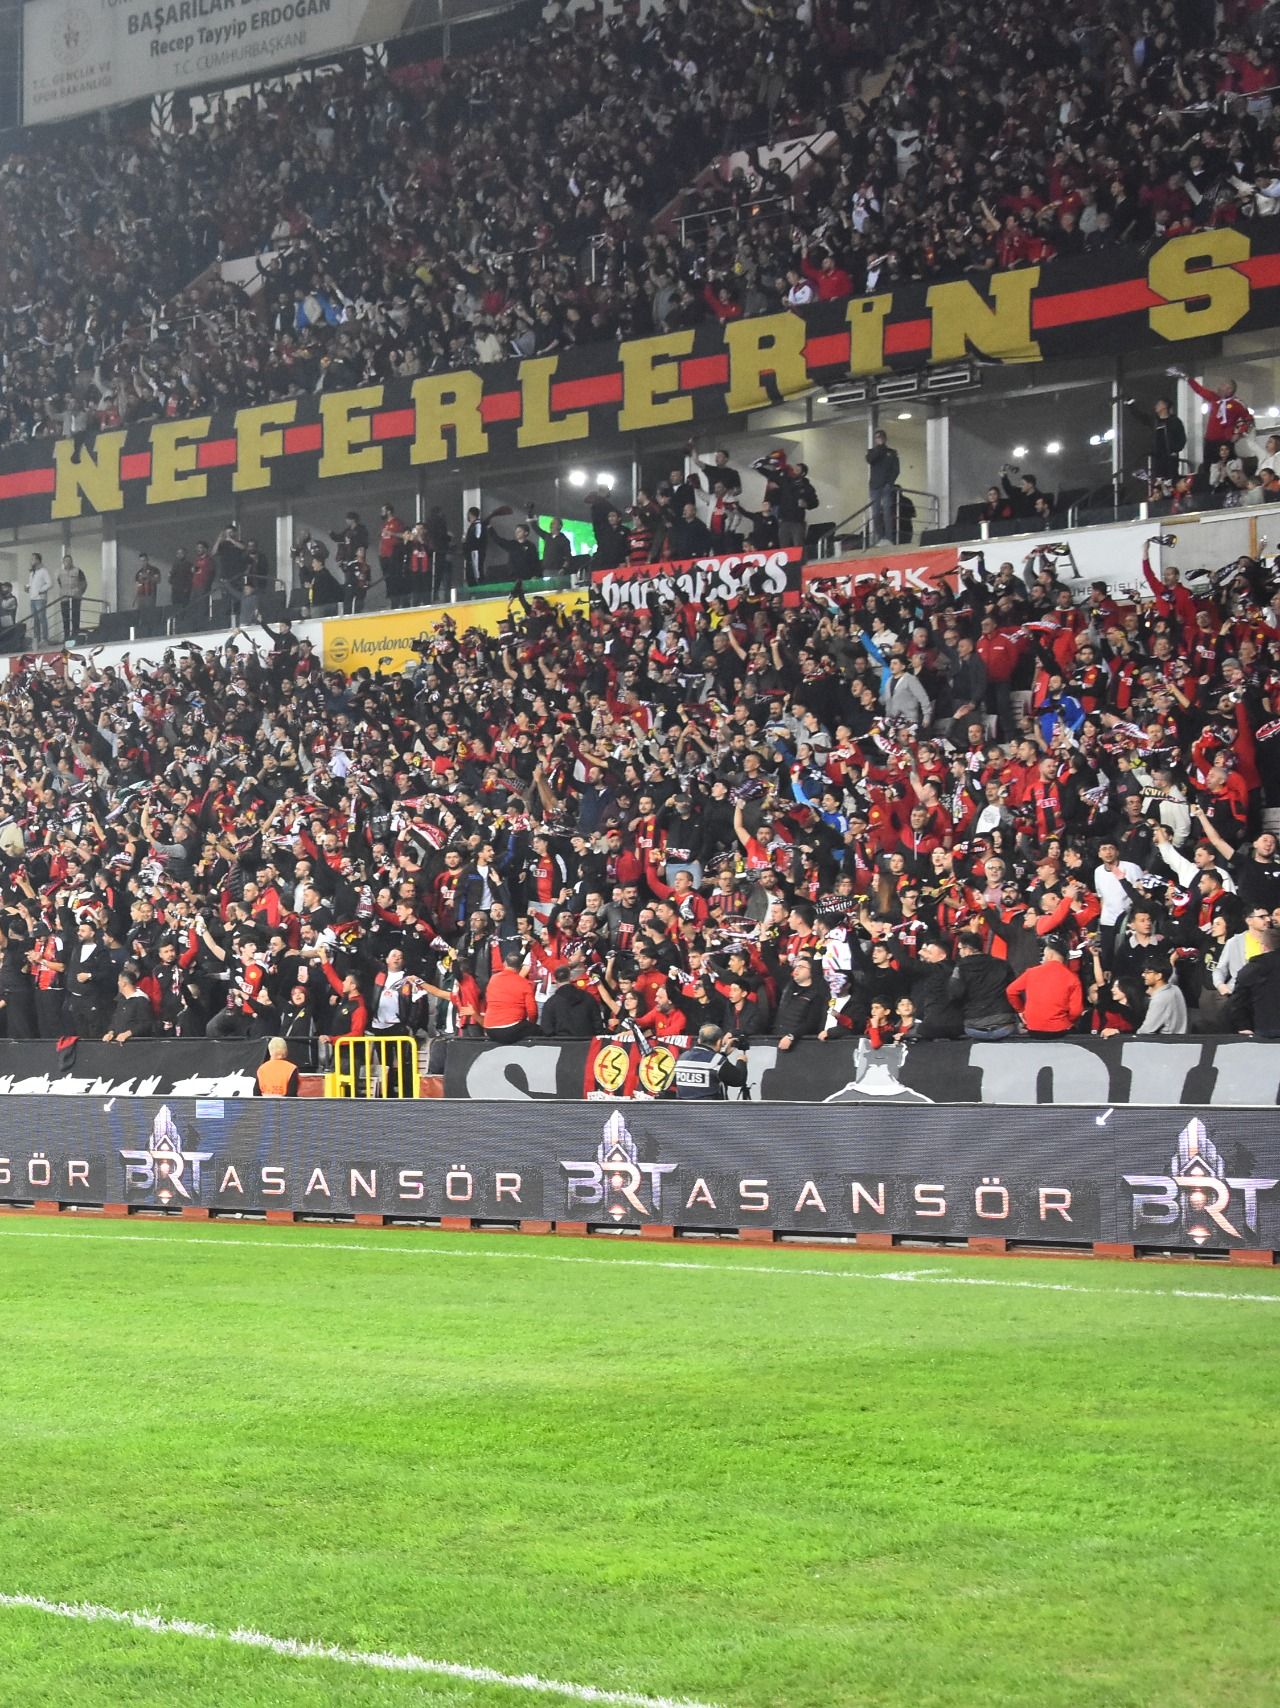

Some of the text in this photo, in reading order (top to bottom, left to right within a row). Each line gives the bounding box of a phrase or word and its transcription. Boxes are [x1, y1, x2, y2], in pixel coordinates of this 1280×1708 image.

[150, 35, 194, 57] Recep
[198, 18, 247, 46] Tayyip
[218, 1163, 522, 1203] ASANSÖR
[684, 1176, 1073, 1222] ASANSÖR
